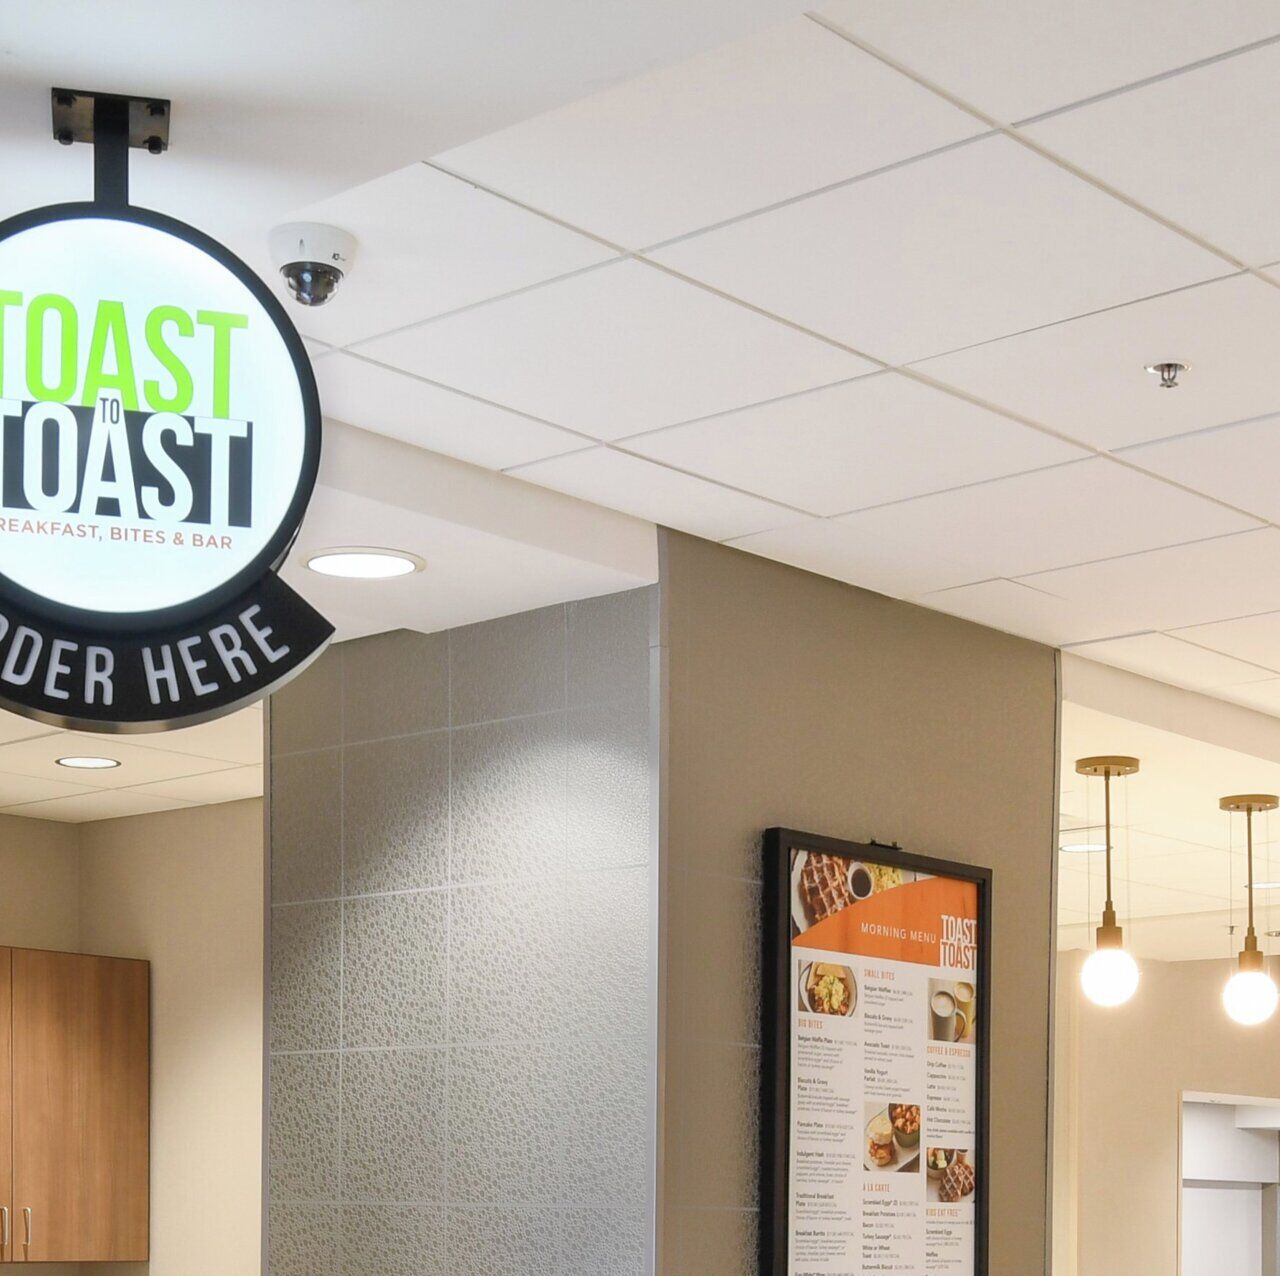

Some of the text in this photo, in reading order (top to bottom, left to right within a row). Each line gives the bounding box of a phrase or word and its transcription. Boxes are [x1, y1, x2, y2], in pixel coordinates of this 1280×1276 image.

[99, 398, 119, 424] TO
[110, 527, 165, 544] BITES
[173, 532, 184, 546] &
[192, 533, 232, 549] BAR
[142, 604, 290, 704] HERE
[861, 922, 936, 944] MORNING MENU
[941, 915, 977, 945] TOAST
[941, 941, 977, 970] TOAST
[864, 969, 895, 981] SMALL BITES
[808, 1020, 823, 1029] BITES
